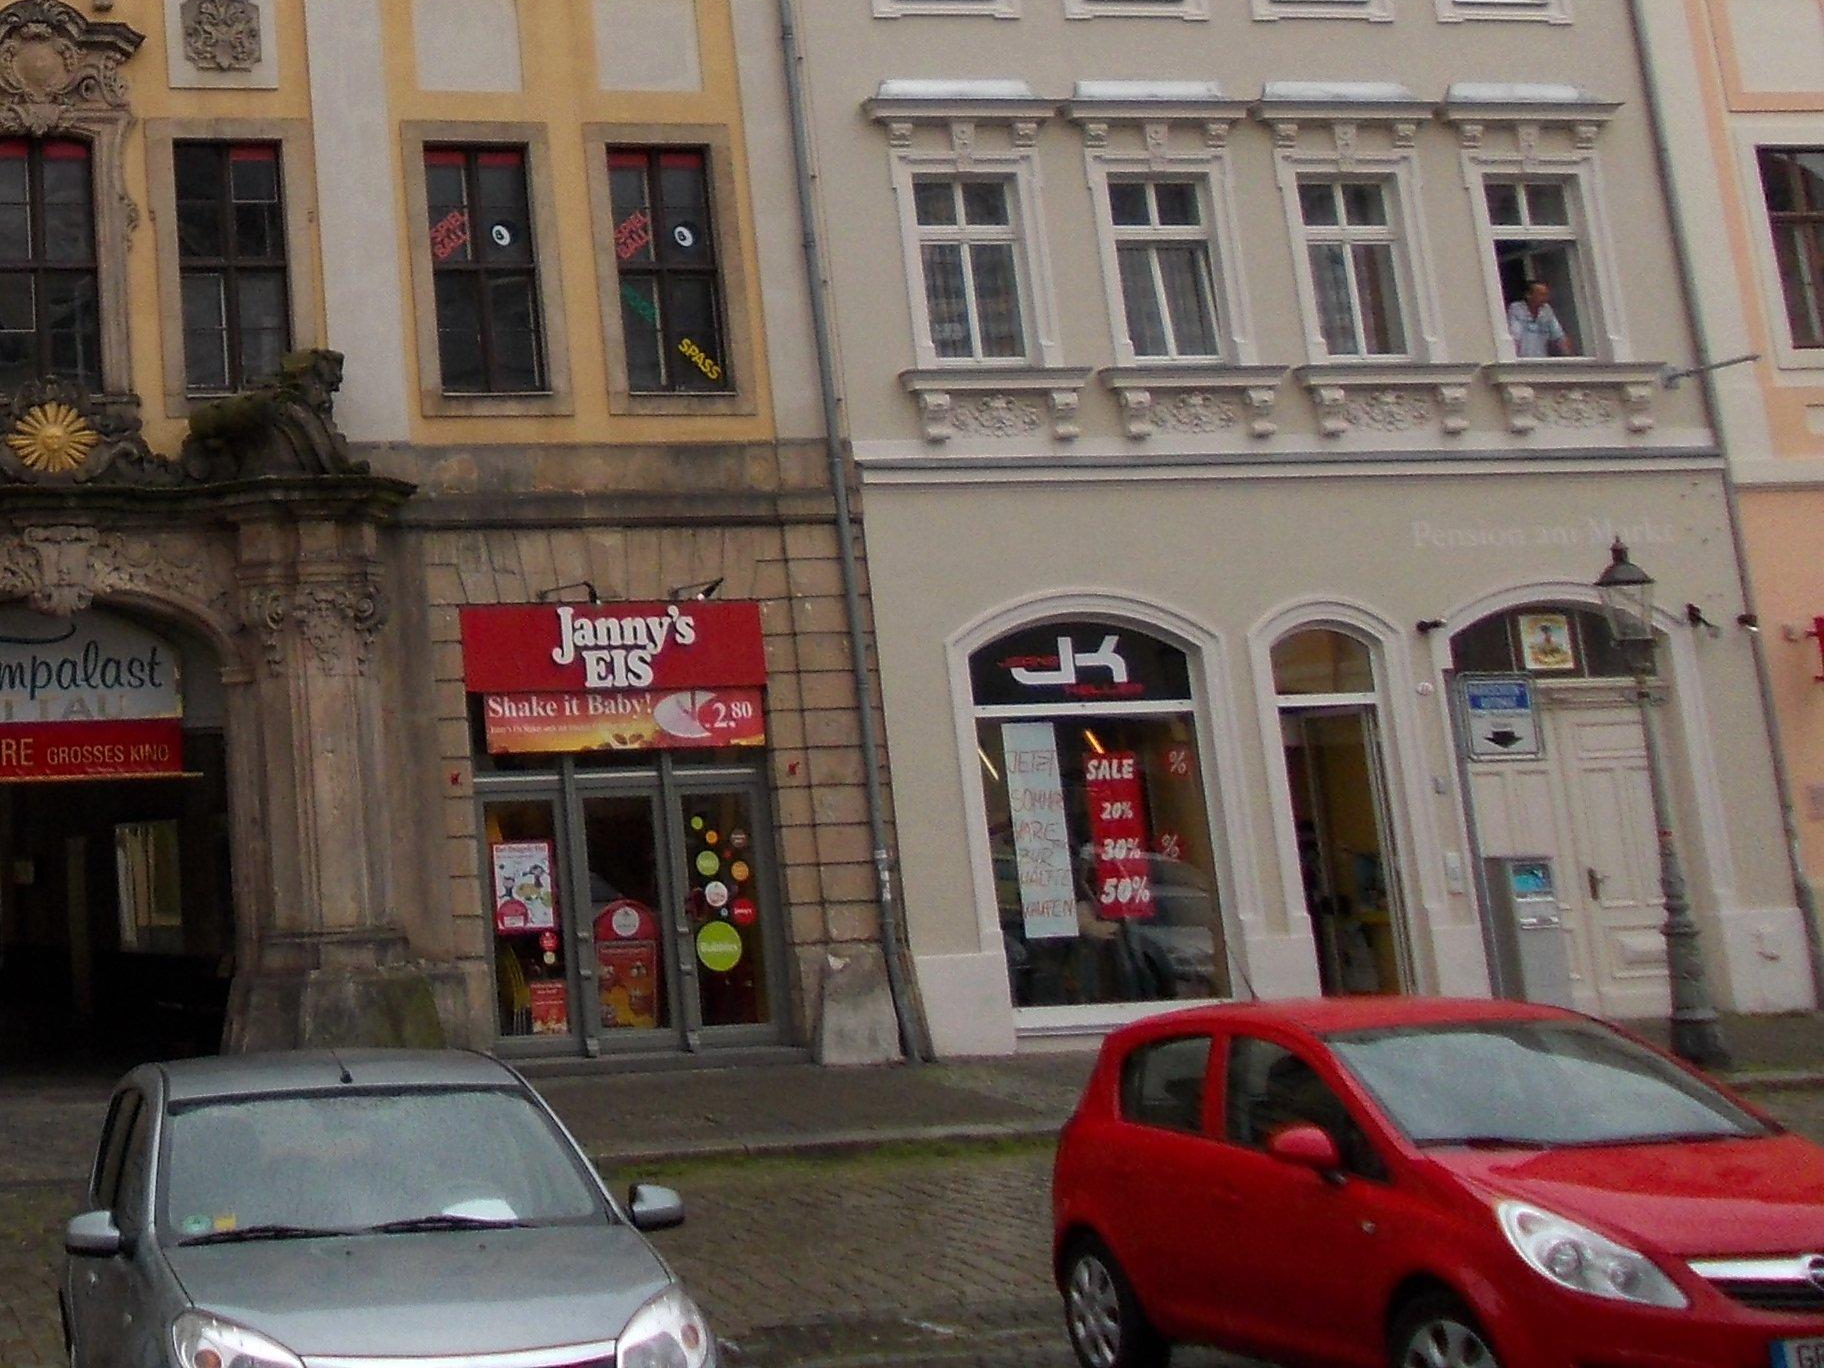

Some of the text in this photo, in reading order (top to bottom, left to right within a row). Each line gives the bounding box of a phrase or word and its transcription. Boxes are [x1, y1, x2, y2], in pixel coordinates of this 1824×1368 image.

[678, 337, 722, 379] SPASS
[552, 605, 696, 666] Janny's
[582, 649, 653, 688] EIS
[488, 692, 652, 719] Shake it Baby!
[712, 701, 753, 729] 2.80
[47, 744, 124, 765] GROSSES
[130, 743, 170, 763] KINO
[1086, 759, 1134, 781] SALE
[1100, 802, 1133, 820] 20%
[1102, 838, 1141, 861] 30%
[1100, 876, 1151, 904] 50%
